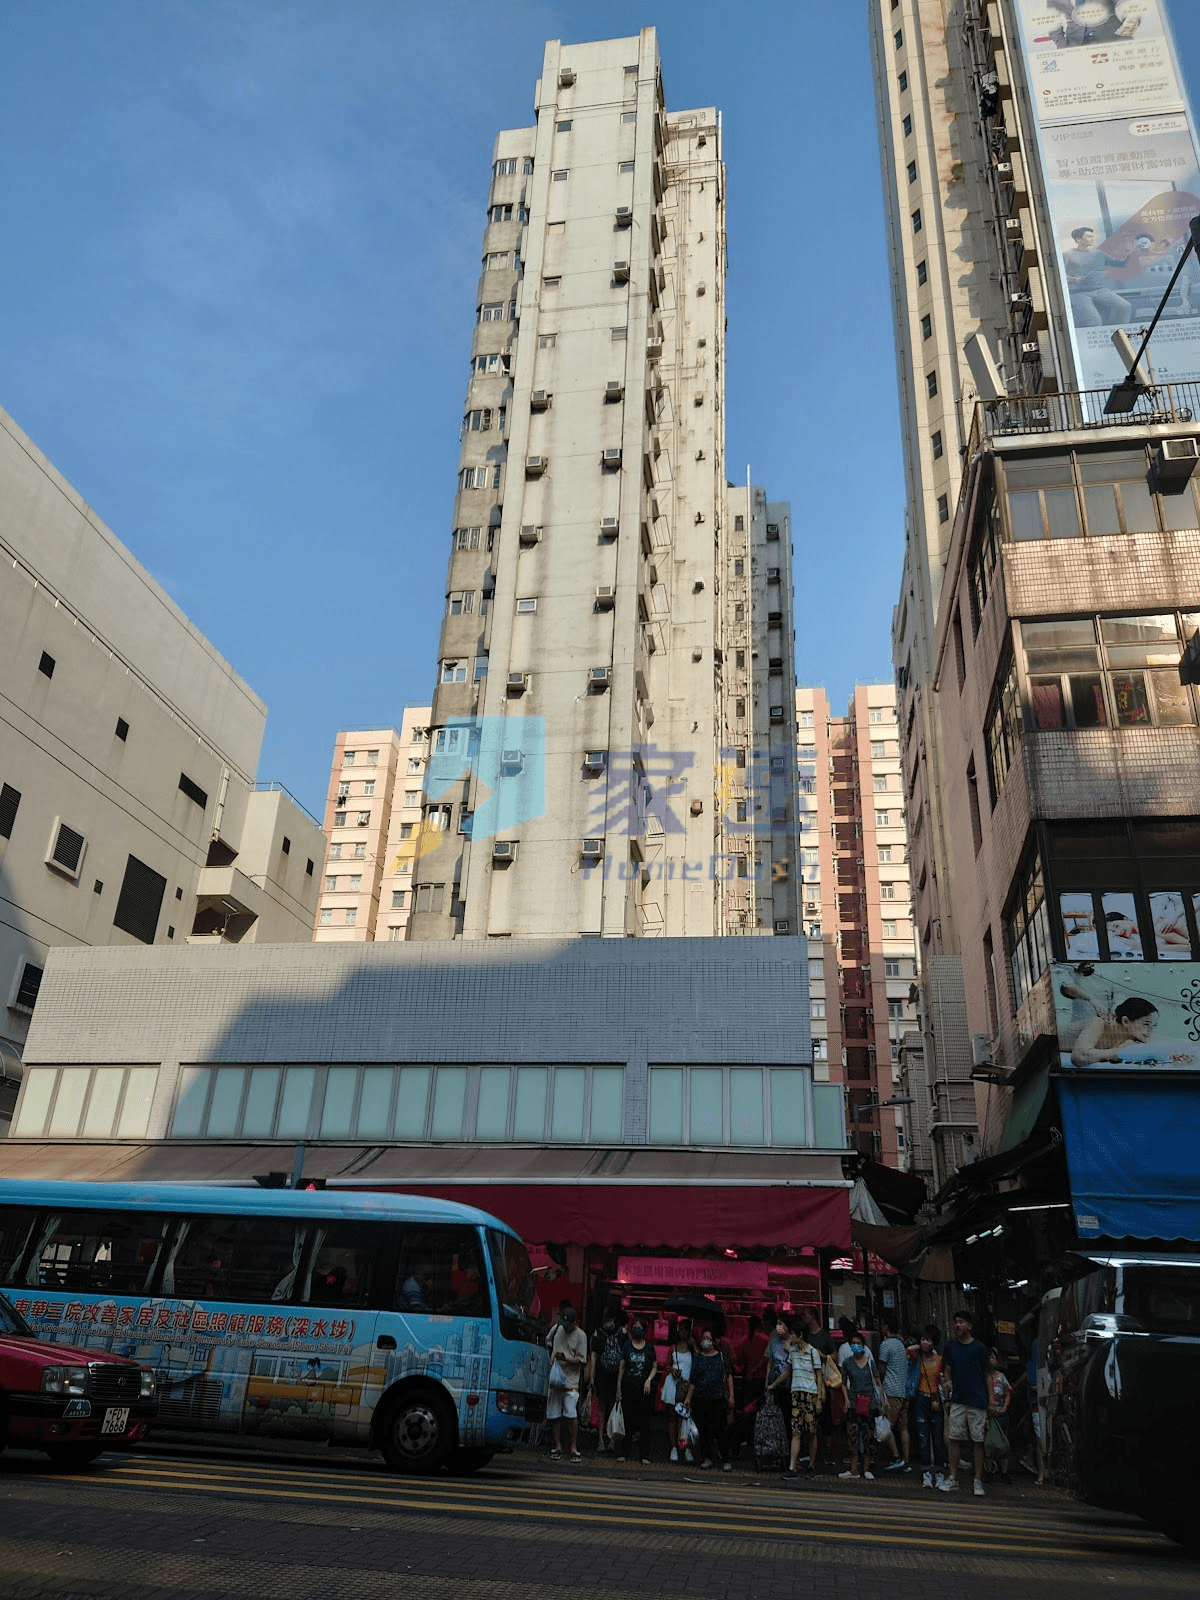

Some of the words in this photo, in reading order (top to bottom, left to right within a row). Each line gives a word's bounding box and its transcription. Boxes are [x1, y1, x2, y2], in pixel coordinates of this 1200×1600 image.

[1051, 133, 1070, 142] VIP
[75, 1402, 82, 1410] 4
[105, 1420, 125, 1432] 7668
